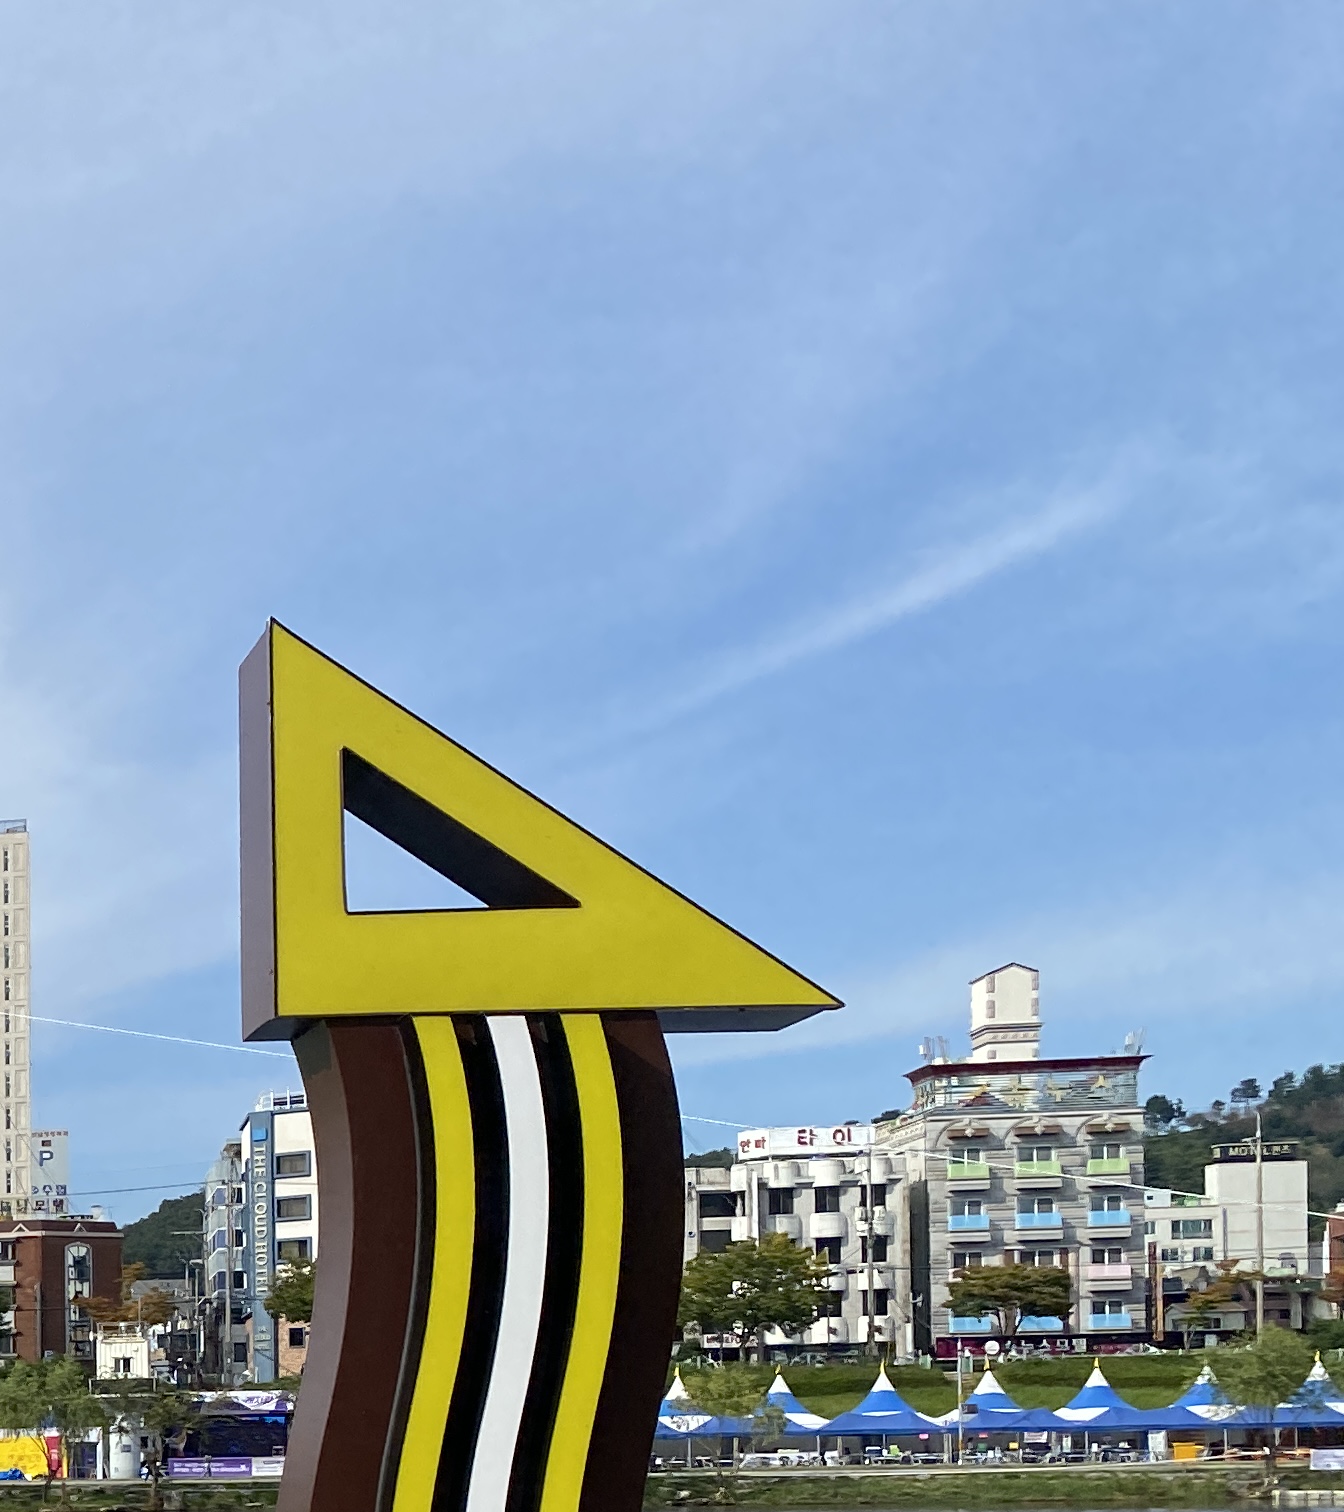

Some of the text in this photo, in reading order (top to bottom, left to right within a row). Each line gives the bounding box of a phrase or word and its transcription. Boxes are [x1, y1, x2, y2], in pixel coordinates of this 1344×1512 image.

[39, 1150, 54, 1167] P
[254, 1145, 267, 1178] THE
[254, 1182, 268, 1239] CLOUD
